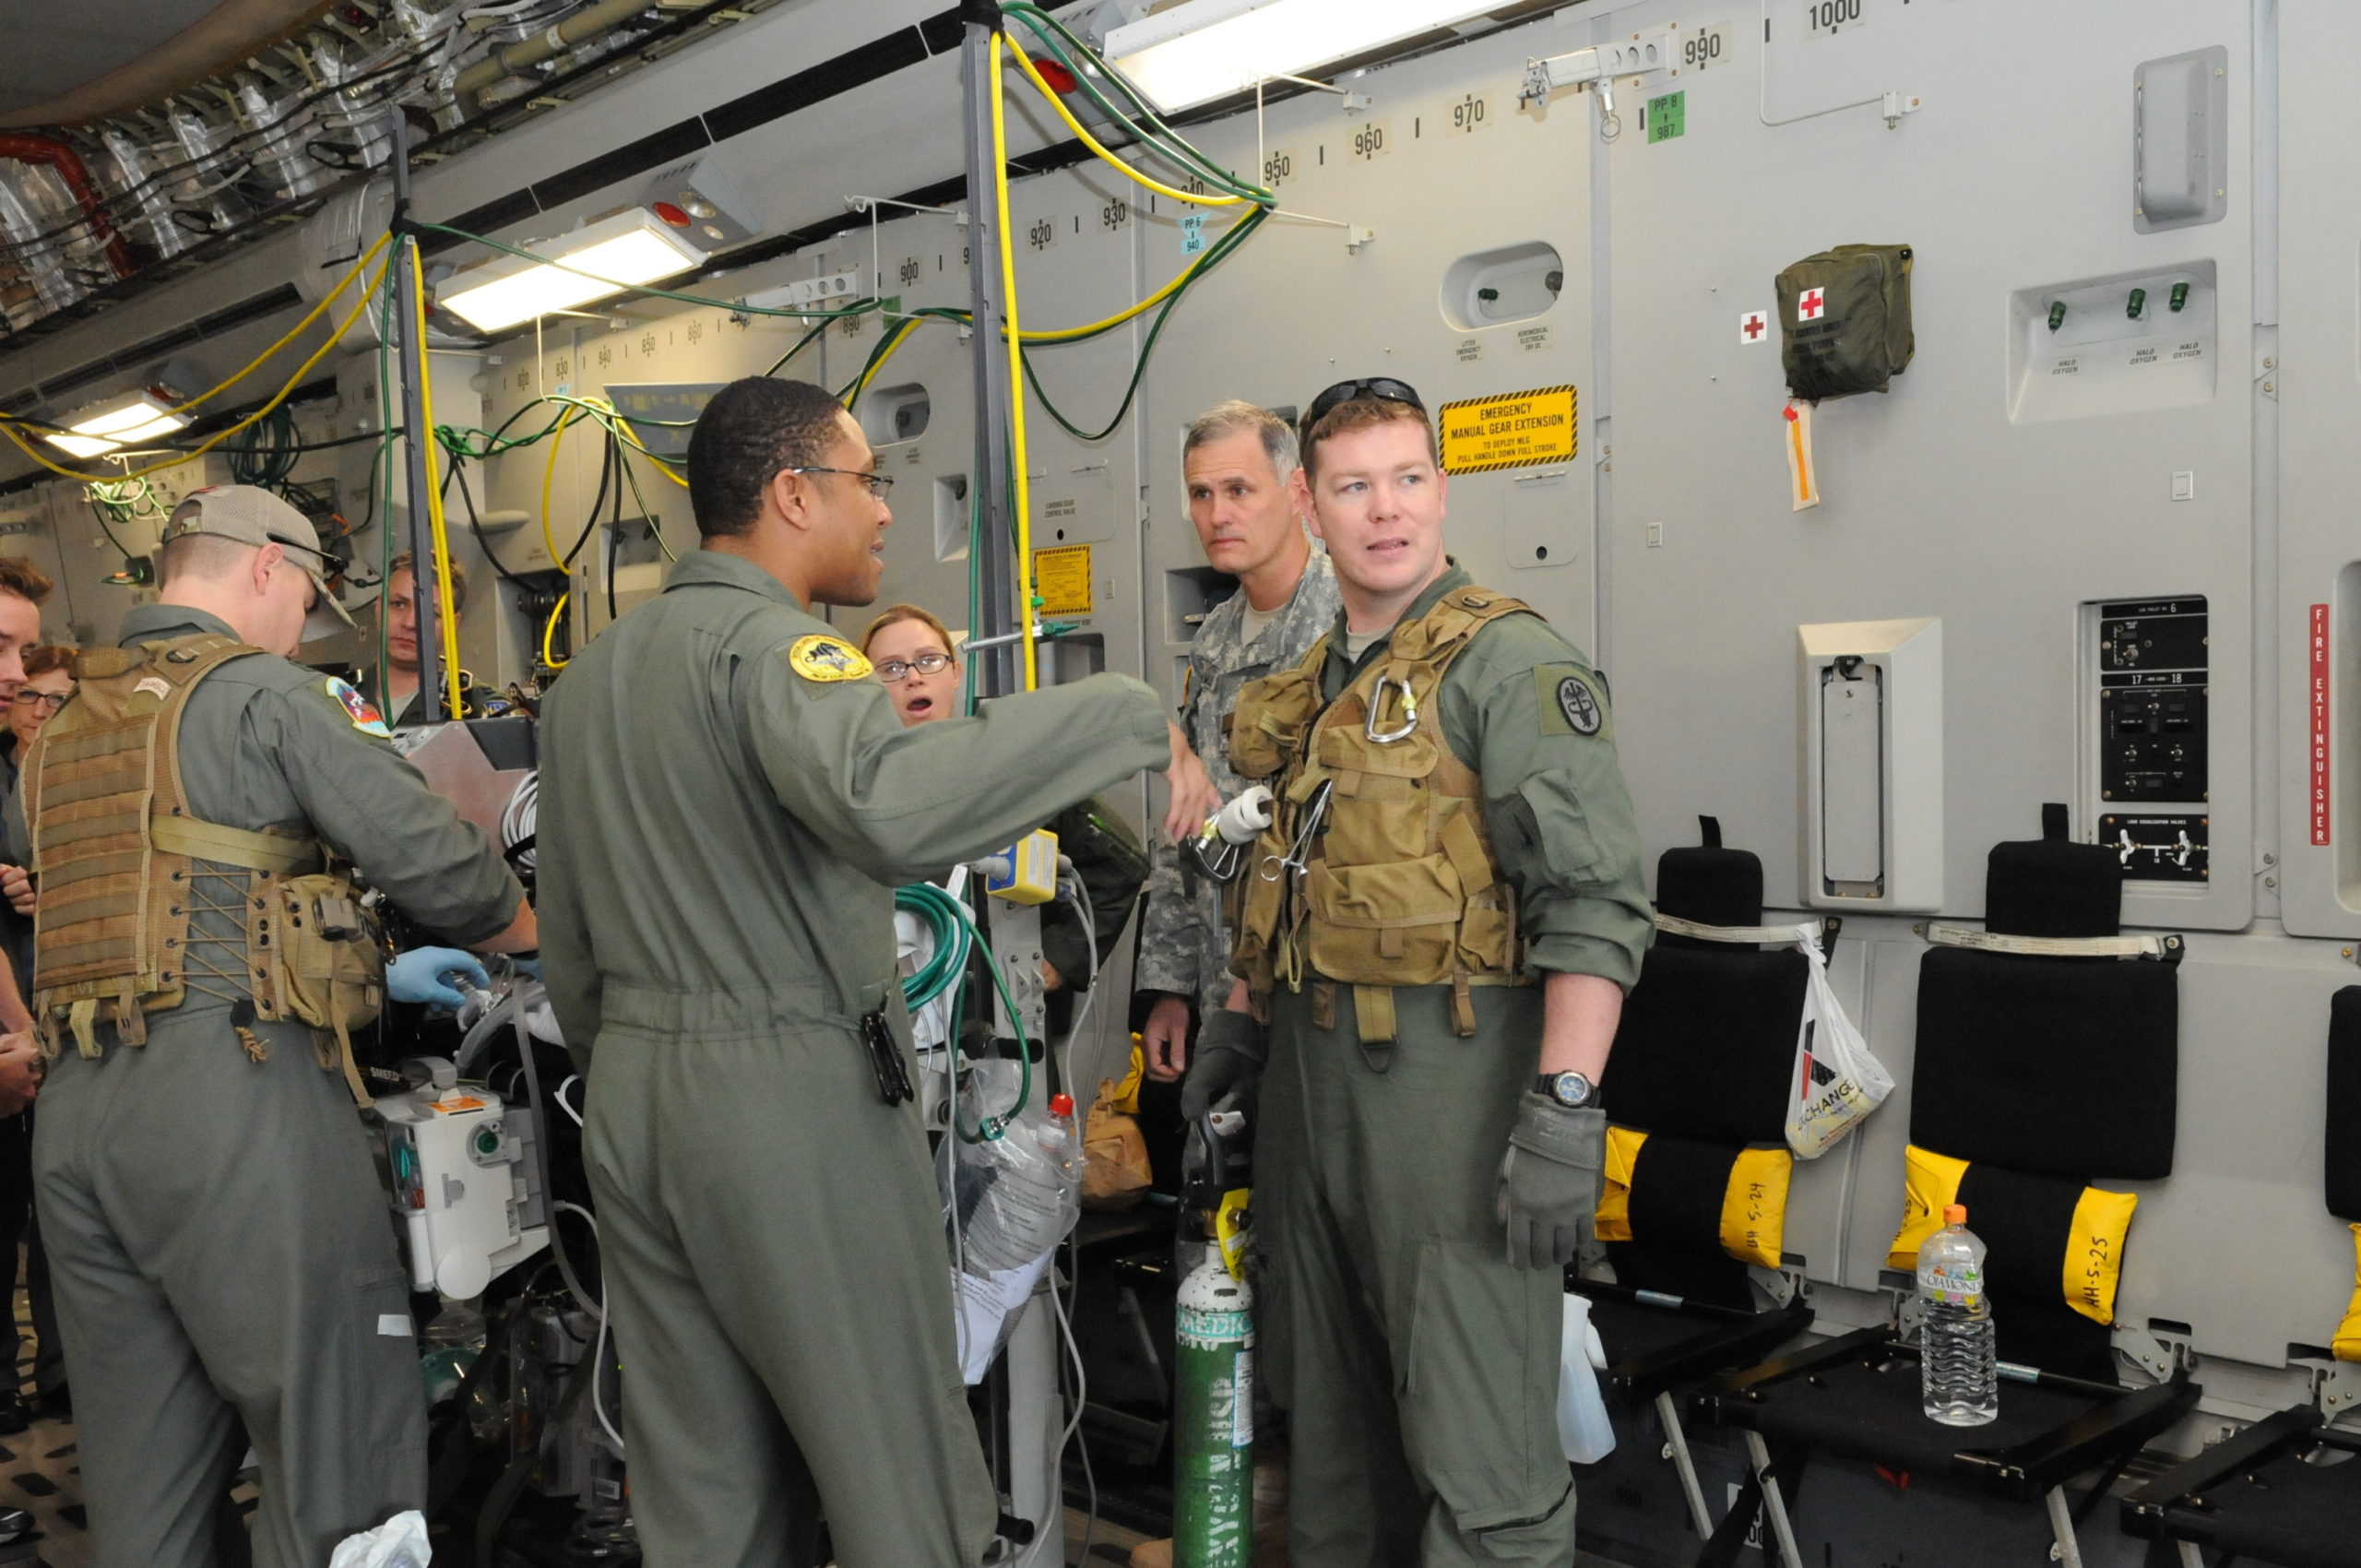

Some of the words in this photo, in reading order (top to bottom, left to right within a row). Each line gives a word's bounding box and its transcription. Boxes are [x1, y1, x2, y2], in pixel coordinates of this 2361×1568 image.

[1809, 0, 1861, 30] 1000
[1685, 33, 1721, 65] 990
[1654, 98, 1667, 112] PP
[1670, 95, 1678, 108] 8
[1453, 99, 1485, 127] 970
[1656, 123, 1676, 139] 987
[1355, 128, 1382, 155] 960
[1264, 156, 1290, 181] 950
[1103, 202, 1126, 226] 930
[1030, 223, 1052, 246] 920
[1187, 239, 1200, 252] 940
[900, 261, 919, 281] 900
[687, 323, 702, 340] 860
[842, 315, 860, 334] 890
[641, 336, 656, 353] 850
[1520, 334, 1546, 345] ELECTRICAL
[2178, 341, 2200, 350] HALO
[599, 349, 611, 365] 840
[1455, 346, 1481, 356] EMERGENCY
[2136, 348, 2155, 357] HALO
[2172, 350, 2202, 360] OXYGEN
[2058, 359, 2077, 368] HALO
[2130, 355, 2158, 365] OXYGEN
[556, 361, 568, 377] 830
[2052, 366, 2079, 375] OXYGEN
[1480, 402, 1533, 421] EMERGENCY
[1451, 425, 1486, 440] MANUAL
[1489, 422, 1512, 435] GEAR
[1514, 413, 1564, 431] EXTENSION
[1483, 441, 1491, 449] TO
[1492, 437, 1515, 448] DEPLOY
[1517, 435, 1530, 445] MLG
[1457, 455, 1471, 463] PULL
[1474, 450, 1496, 461] HANDLE
[1498, 448, 1516, 458] DOWN
[1517, 446, 1532, 456] FULL
[1534, 443, 1557, 454] STROKE
[2170, 602, 2177, 613] 6
[2315, 609, 2323, 662] FIRE
[2131, 674, 2142, 685] 17
[2171, 672, 2182, 683] 18
[2315, 678, 2324, 842] EXTINGUISHER
[1927, 1275, 1980, 1292] DIAMOND
